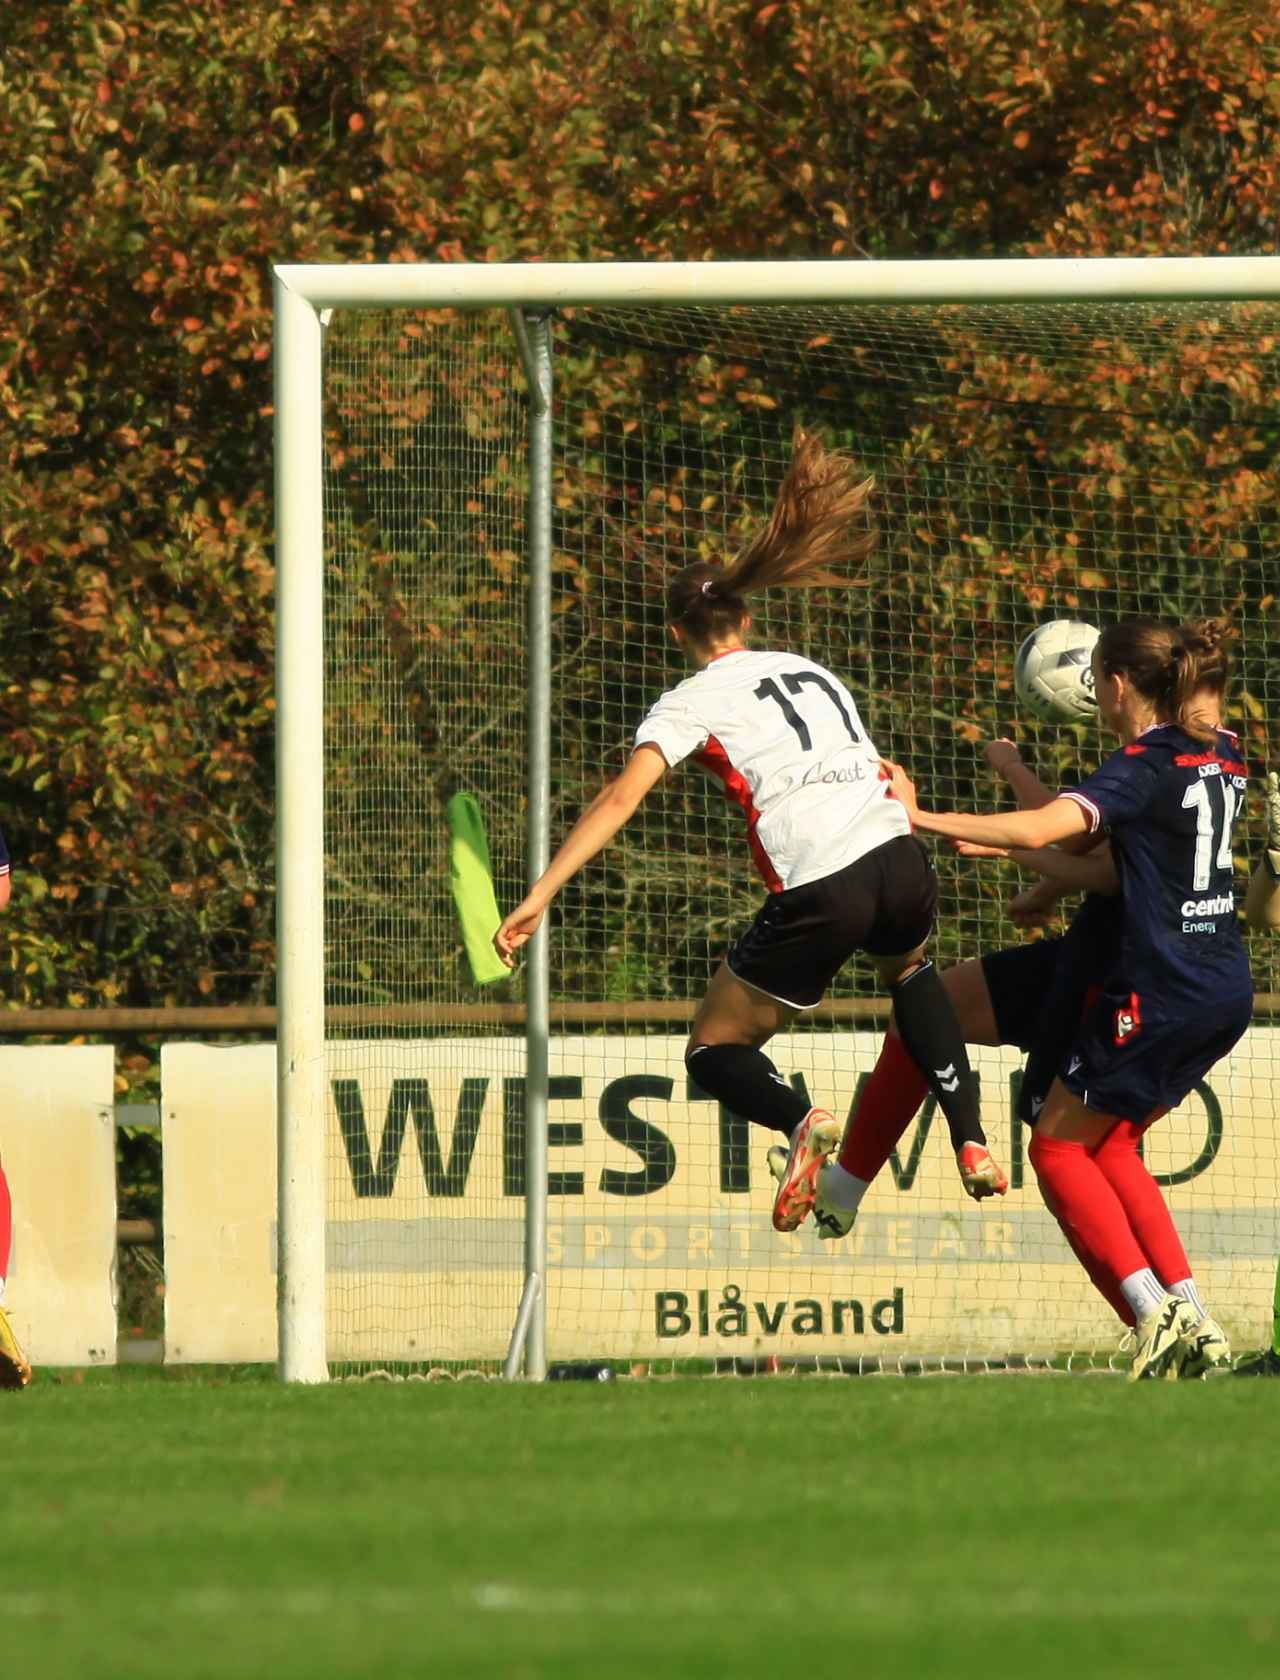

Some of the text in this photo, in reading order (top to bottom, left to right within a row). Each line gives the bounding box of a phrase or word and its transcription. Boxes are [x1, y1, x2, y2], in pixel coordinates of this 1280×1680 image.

[753, 671, 861, 752] 17
[331, 1068, 1223, 1198] WESTD
[654, 1284, 905, 1338] Blåvand
